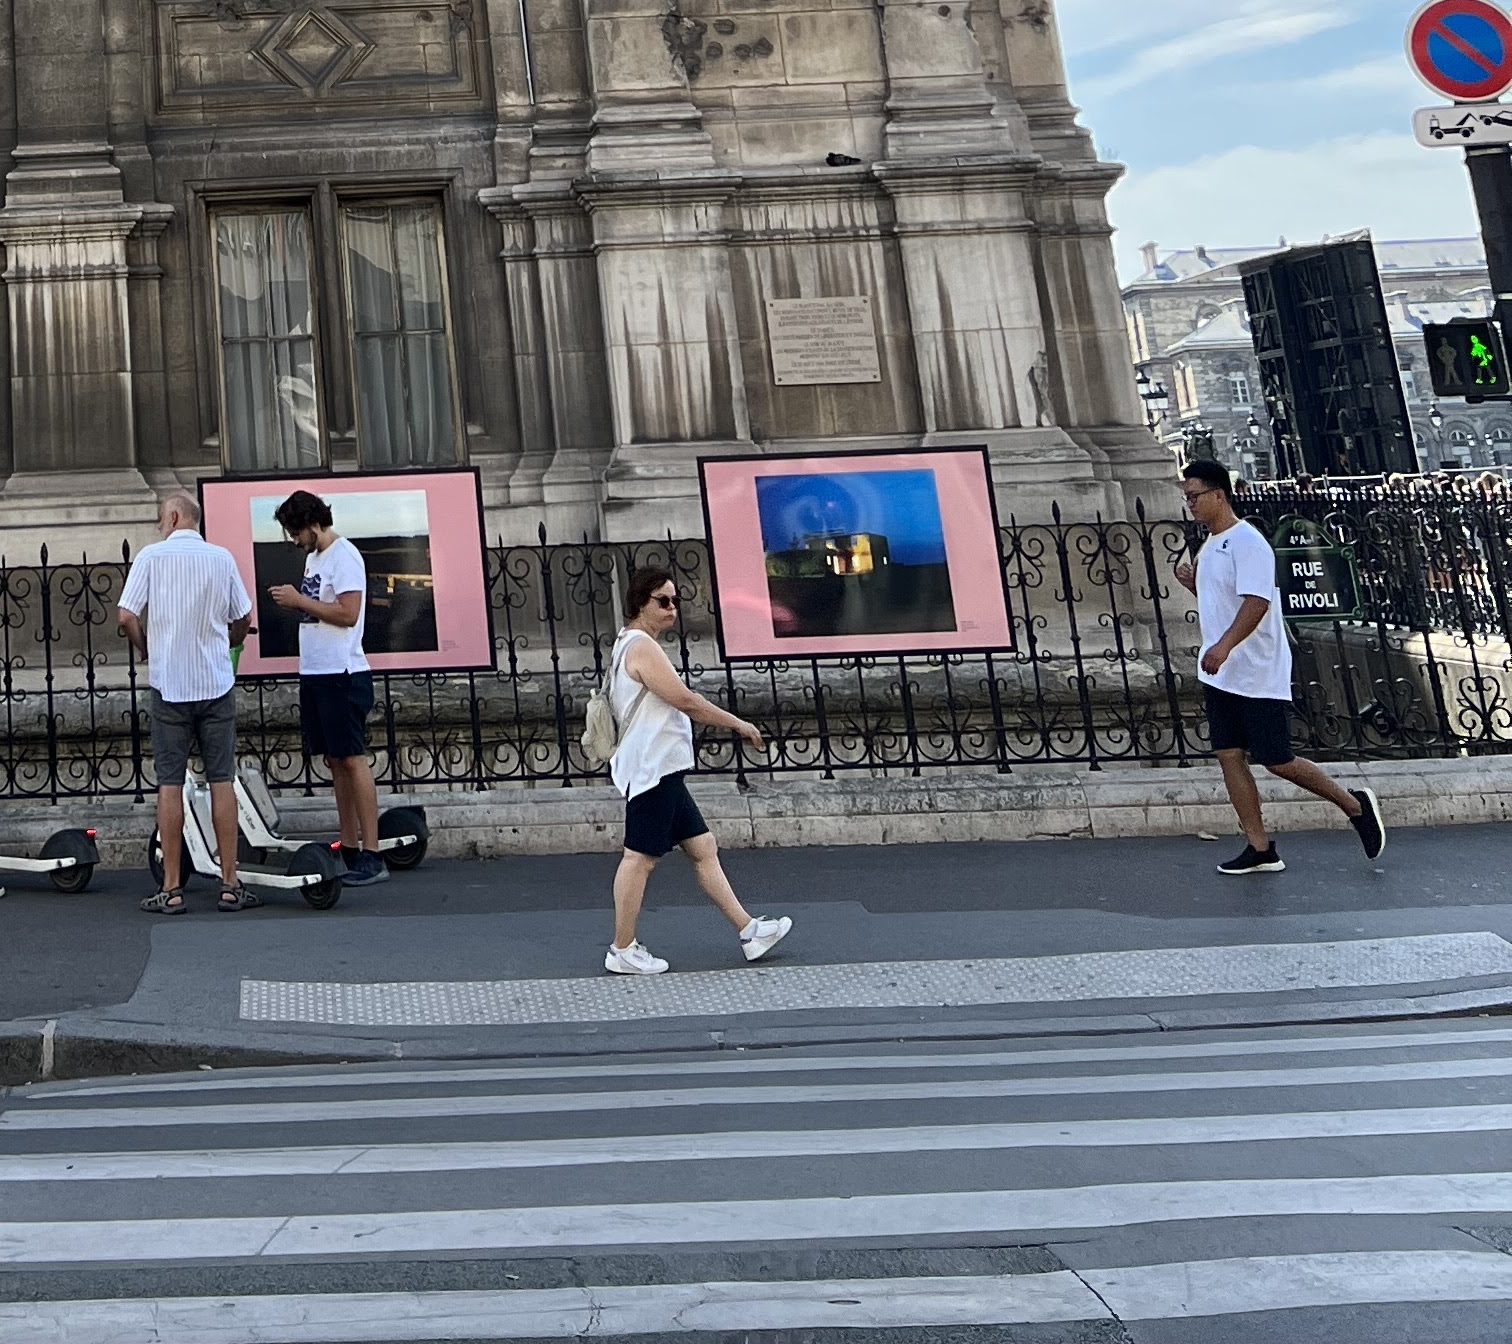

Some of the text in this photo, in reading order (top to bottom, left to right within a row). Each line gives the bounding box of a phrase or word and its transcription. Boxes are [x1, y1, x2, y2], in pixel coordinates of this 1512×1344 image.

[1292, 562, 1324, 576] RUE
[1304, 580, 1316, 589] DE
[1288, 592, 1339, 608] RIVOLI
